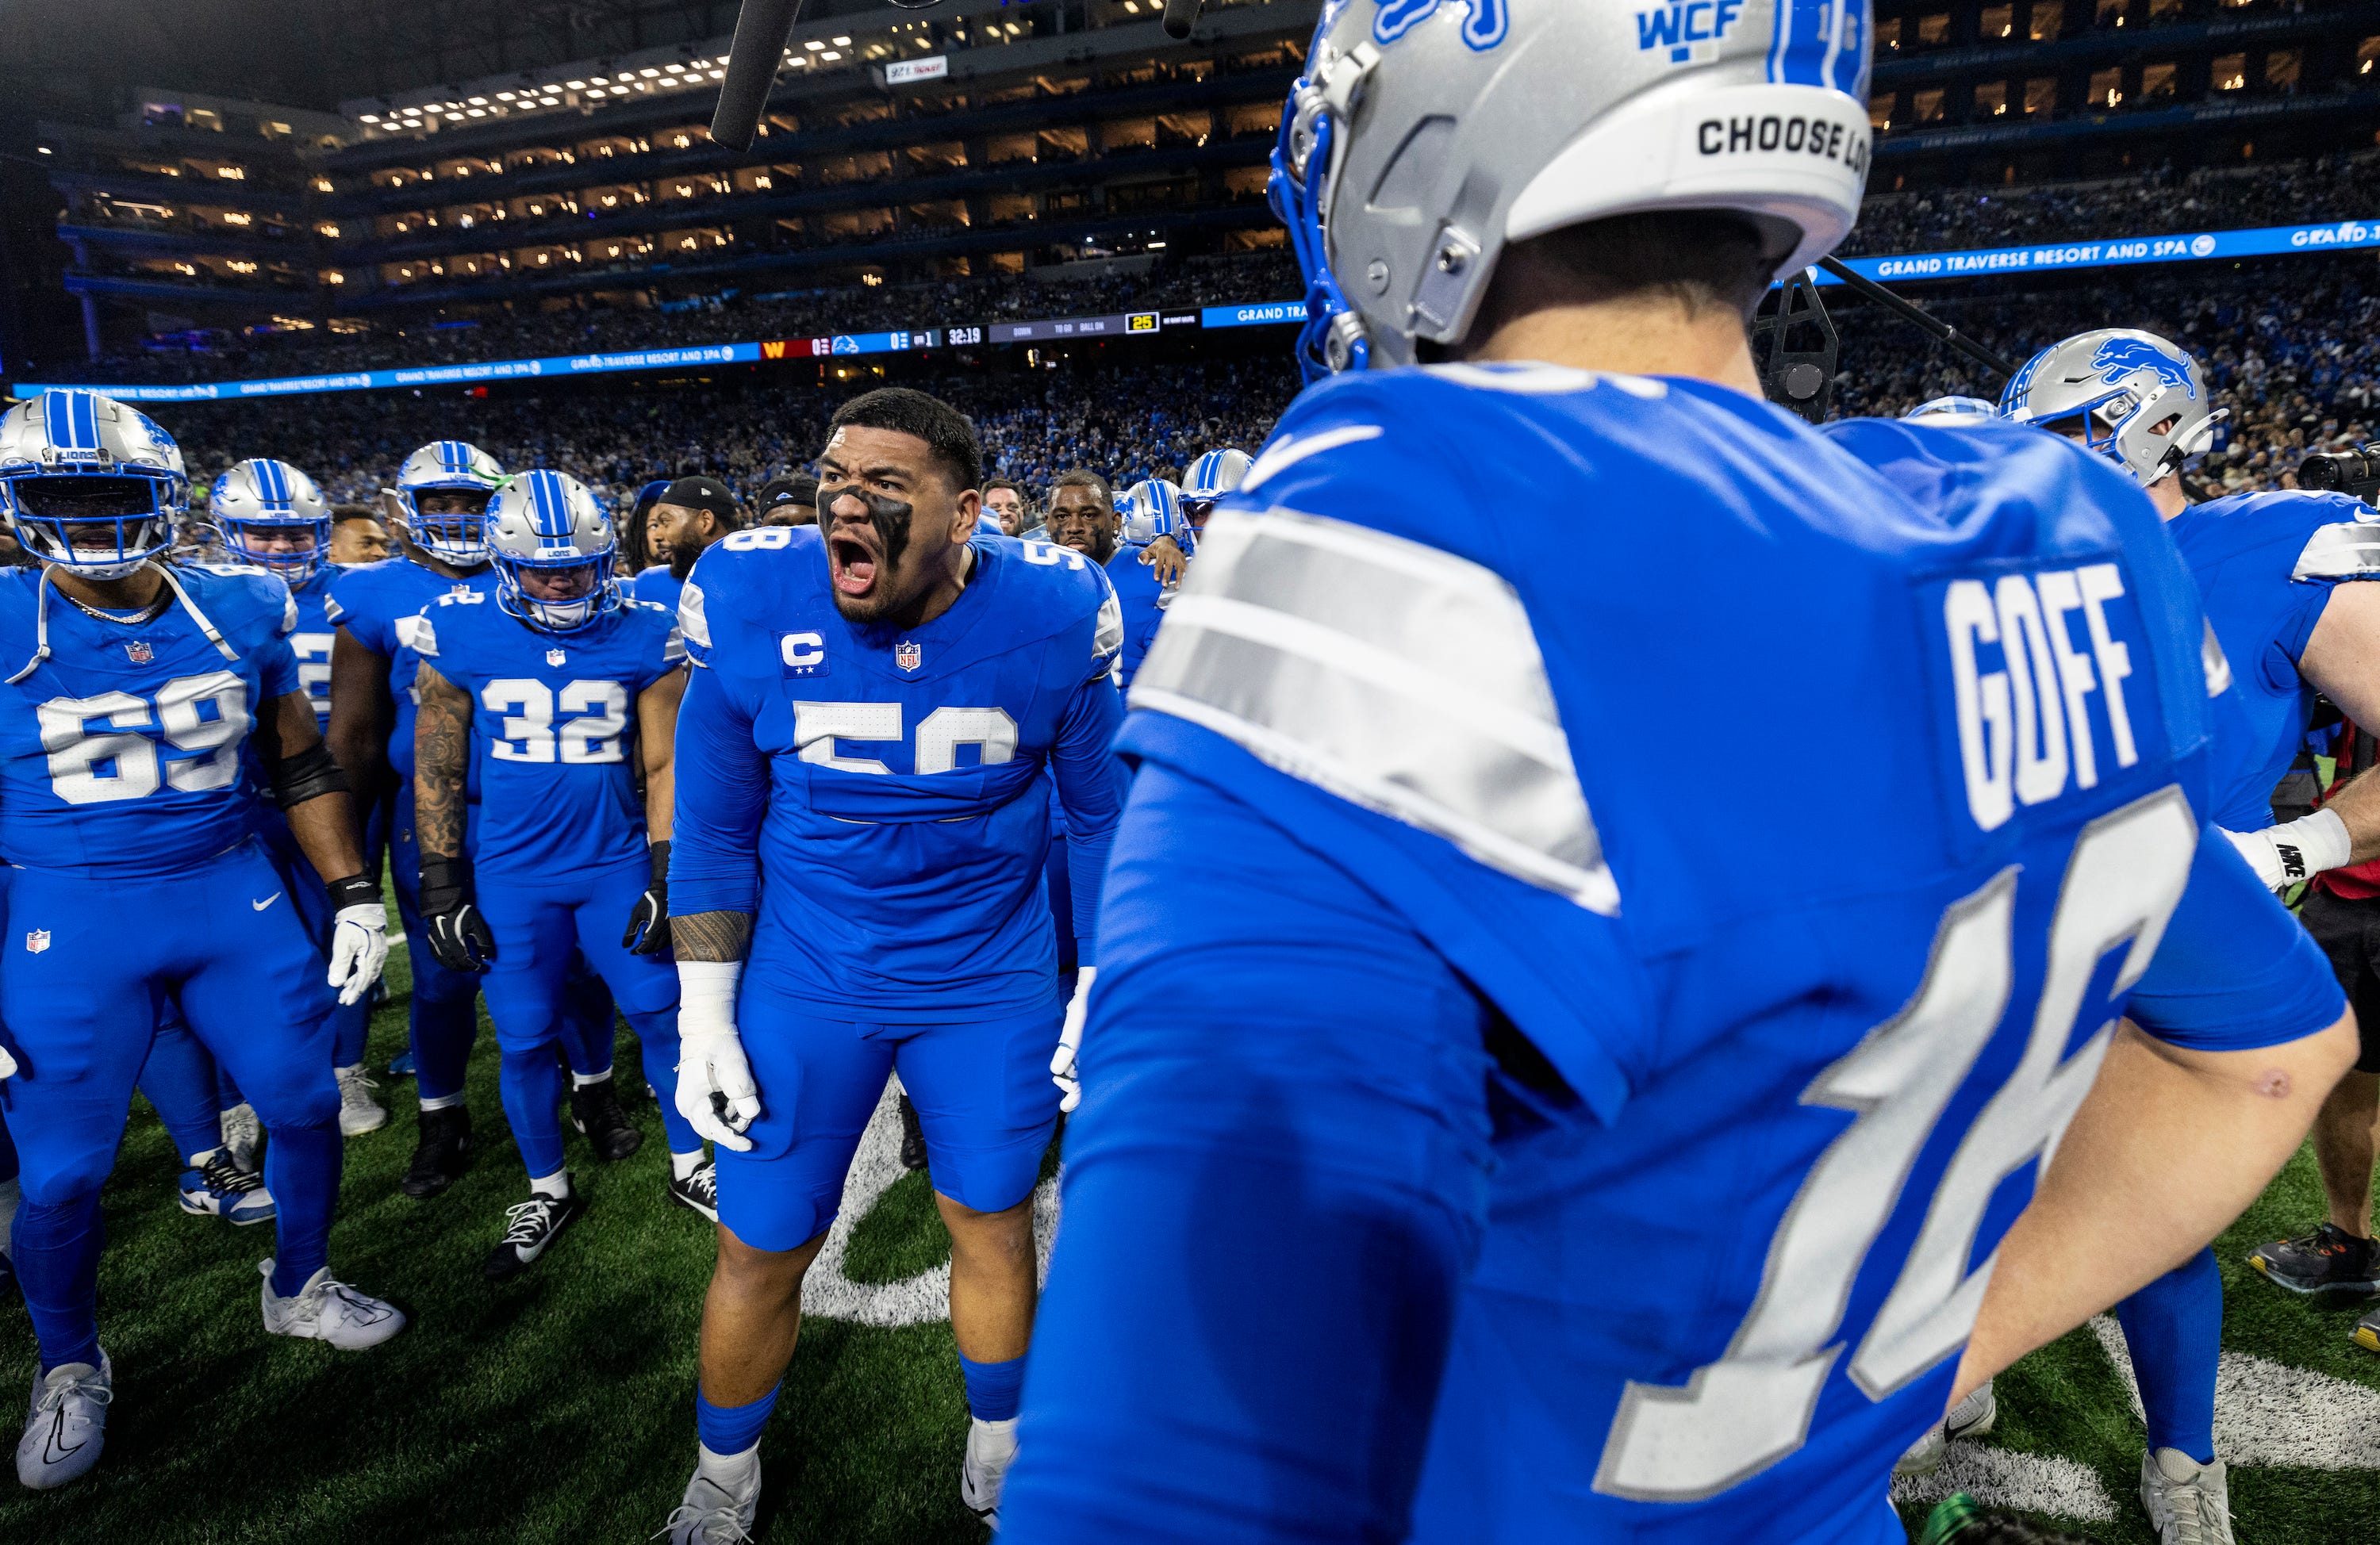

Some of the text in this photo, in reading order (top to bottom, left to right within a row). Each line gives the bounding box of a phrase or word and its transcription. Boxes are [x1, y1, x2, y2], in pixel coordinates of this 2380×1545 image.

[1637, 0, 1744, 51] WCF
[1699, 117, 1844, 159] CHOOSE
[1879, 239, 2187, 277] GRAND TRAVERSE RESORT AND SPA
[1013, 327, 1031, 337] DOWN
[1079, 322, 1094, 332] BALL
[1132, 315, 1153, 330] 25
[1237, 307, 1284, 322] GRAND
[604, 355, 645, 367] TRAVERSE
[647, 351, 680, 364] RESORT
[681, 350, 702, 362] AND
[704, 349, 720, 360] SPA
[763, 342, 785, 358] W
[924, 332, 932, 347] 1
[949, 327, 981, 345] 32:19
[59, 450, 94, 460] LIONS
[781, 632, 824, 667] C
[1944, 563, 2139, 833] GOFF
[36, 669, 250, 805] 69
[481, 678, 628, 765] 32
[2275, 843, 2306, 878] NIKE
[1591, 785, 2201, 1501] 16
